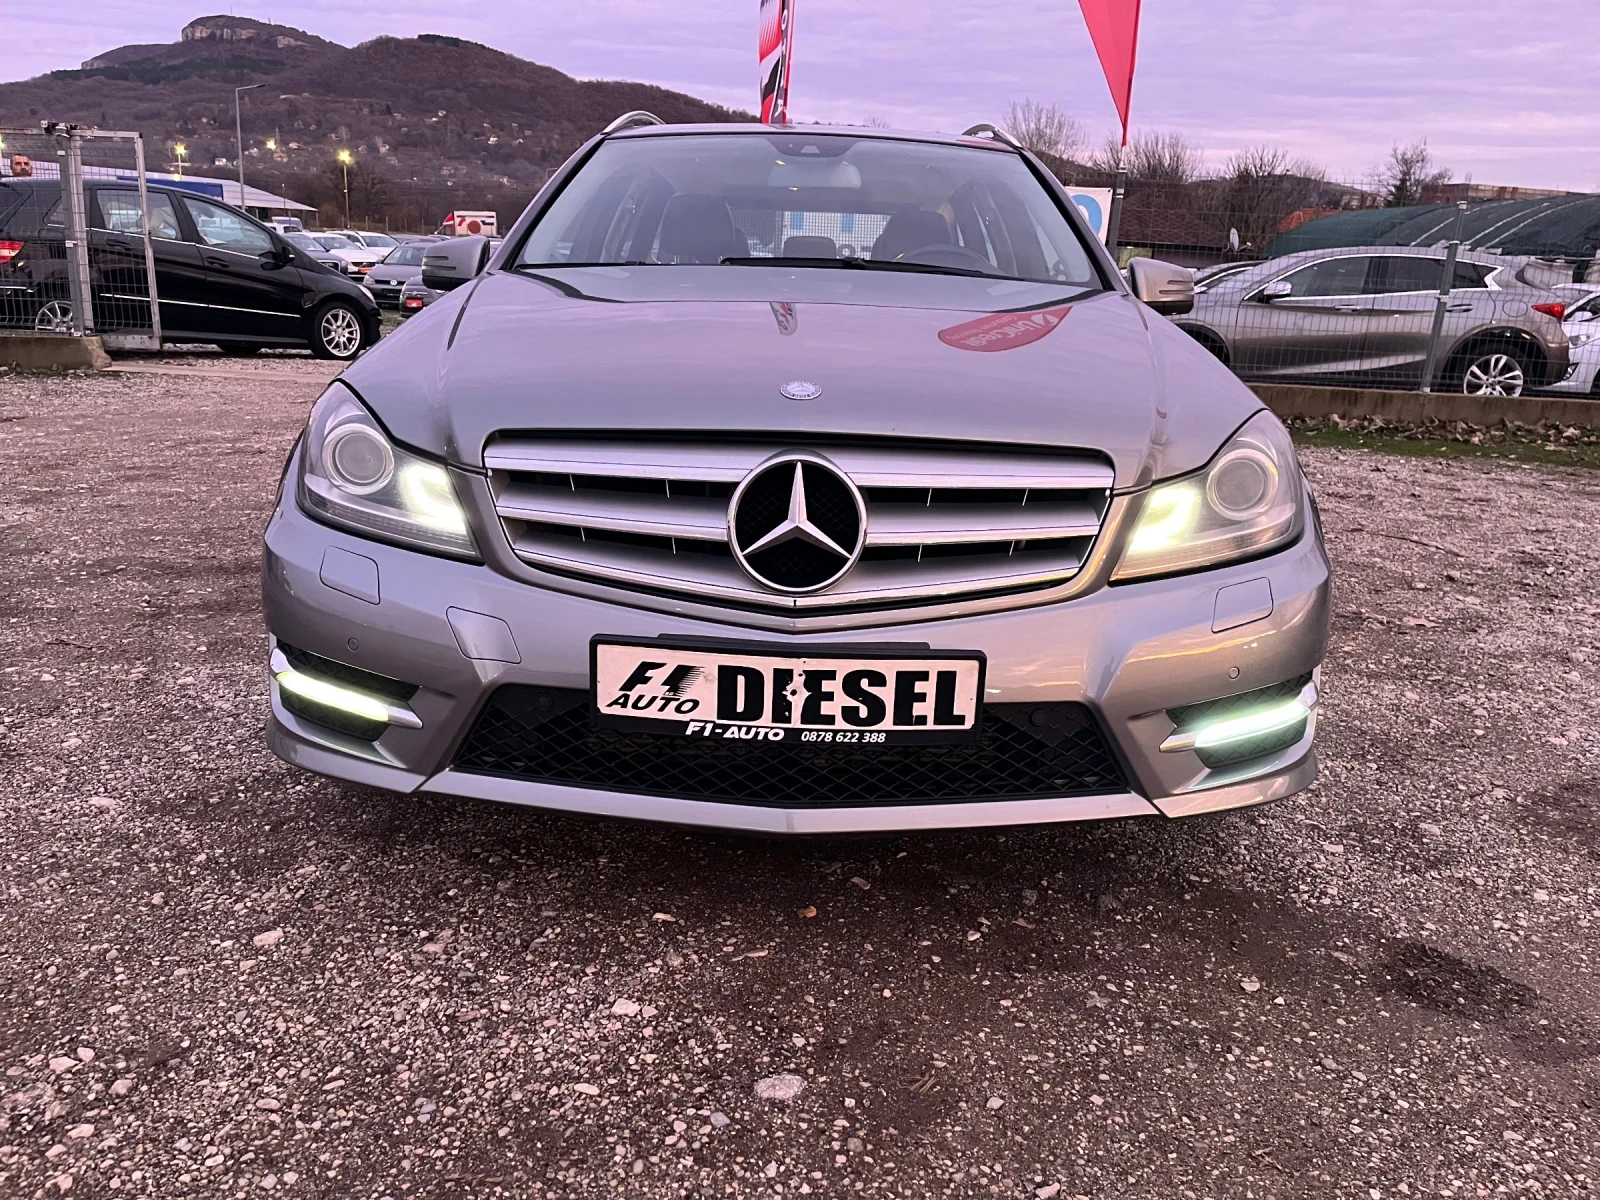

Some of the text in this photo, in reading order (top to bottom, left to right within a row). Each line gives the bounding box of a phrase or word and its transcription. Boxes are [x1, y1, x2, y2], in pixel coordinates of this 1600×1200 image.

[605, 693, 701, 714] AUTO
[717, 664, 966, 728] DIESEL
[685, 721, 886, 743] F1-AUTO 0878 622 388
